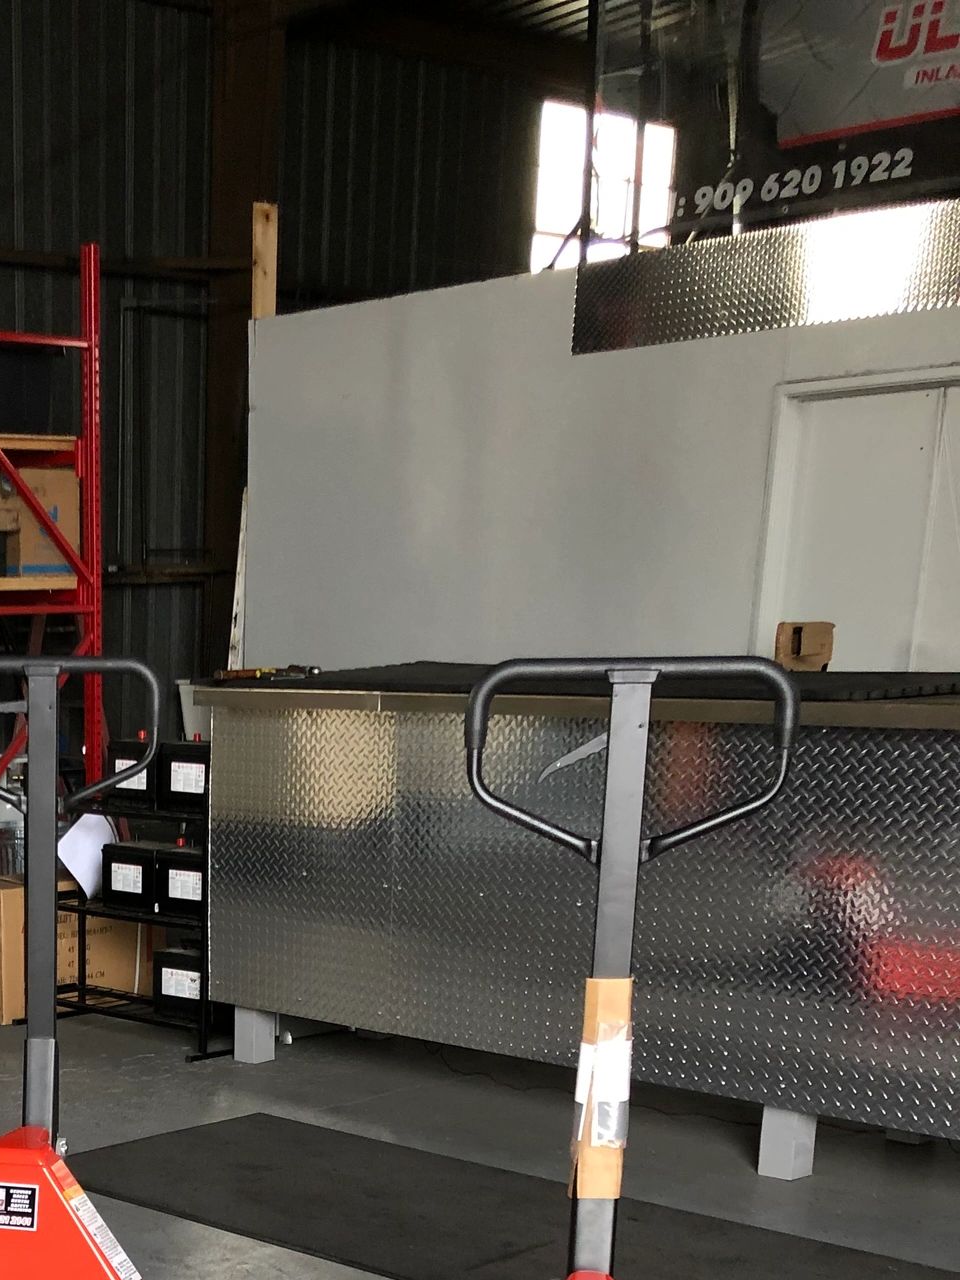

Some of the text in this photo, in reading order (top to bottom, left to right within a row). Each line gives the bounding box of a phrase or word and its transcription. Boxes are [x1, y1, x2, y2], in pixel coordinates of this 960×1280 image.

[694, 178, 754, 215] 909
[760, 164, 822, 202] 620
[831, 147, 914, 189] 1922
